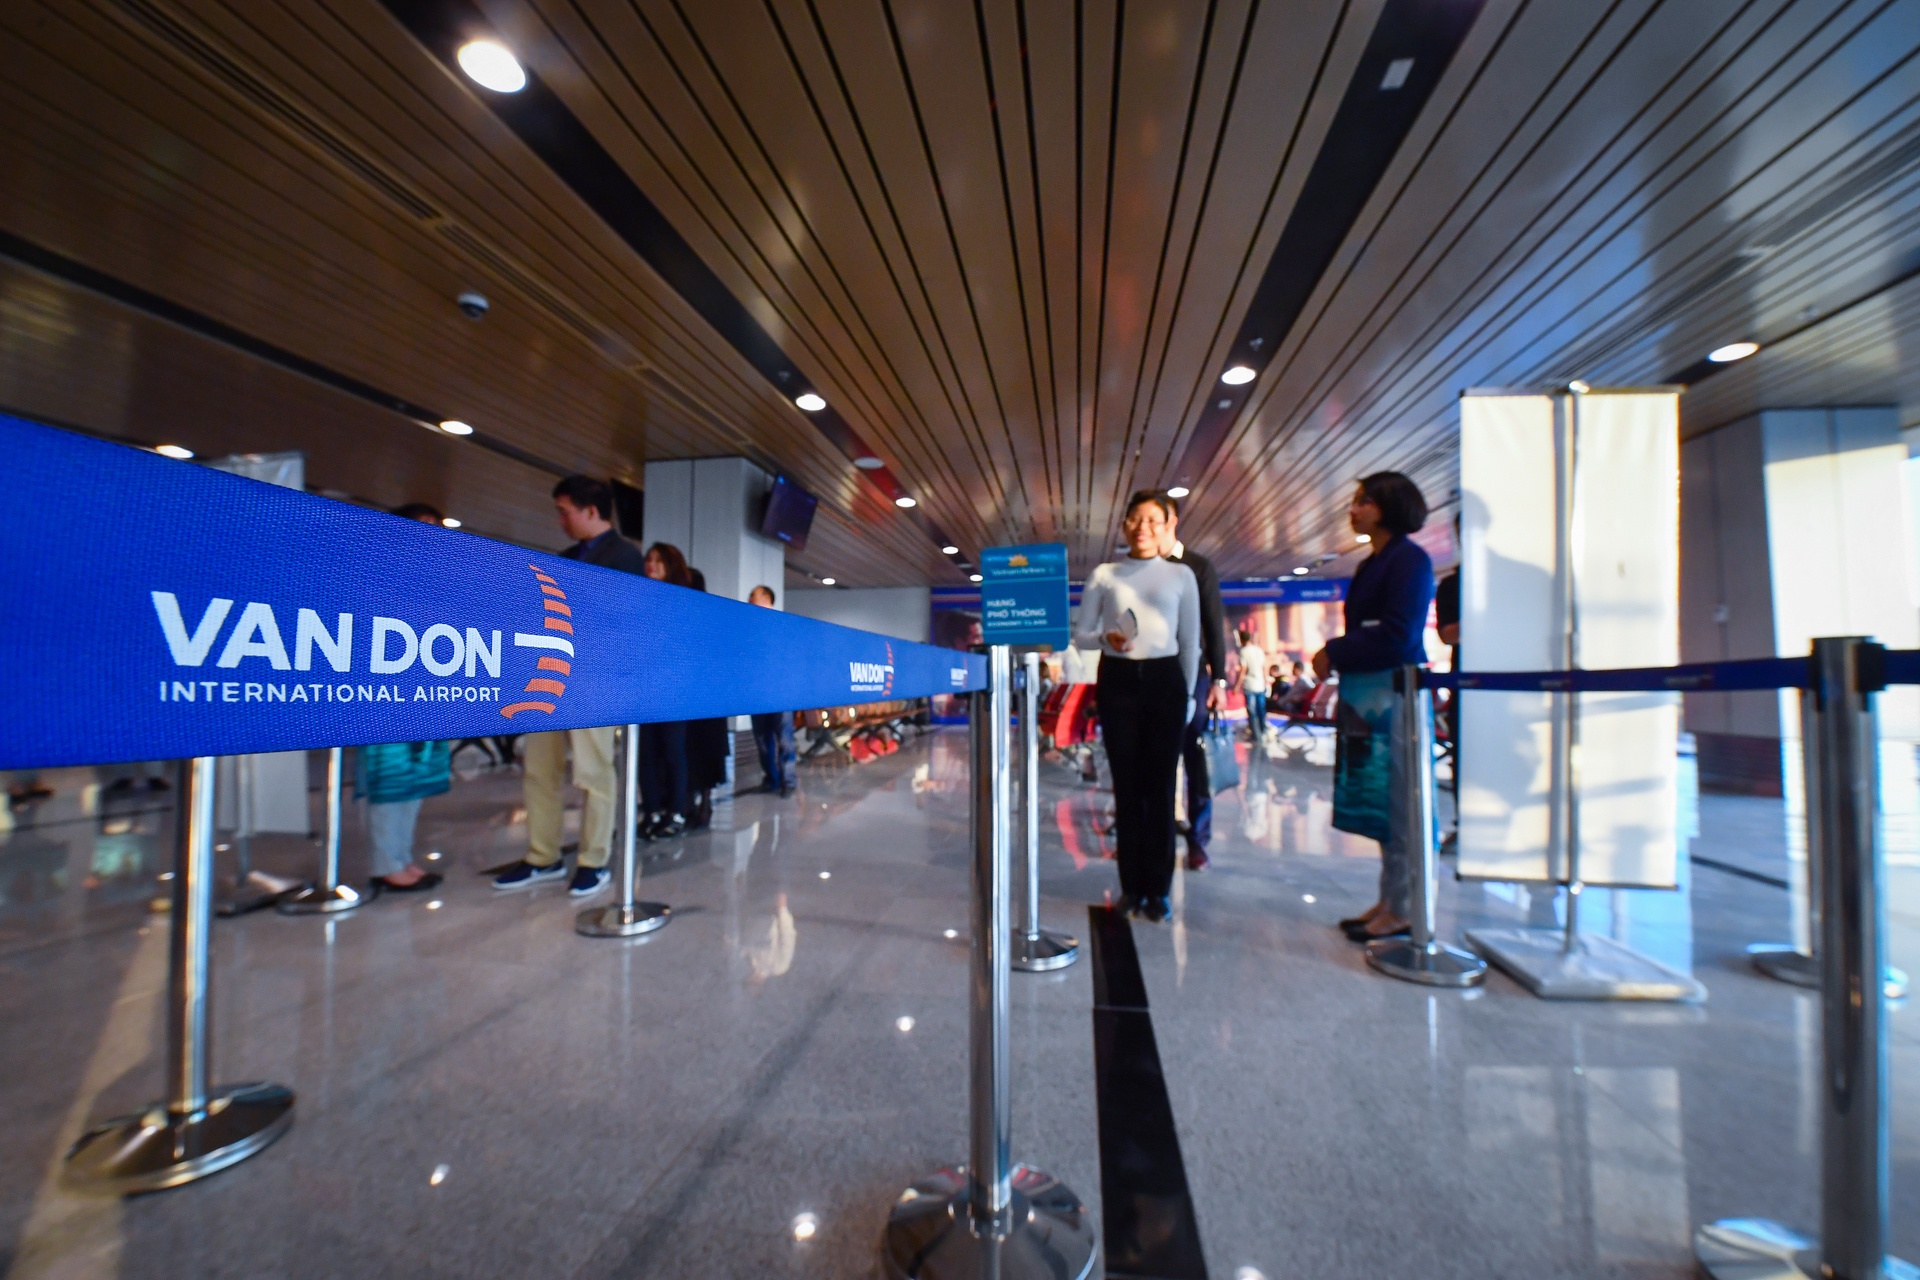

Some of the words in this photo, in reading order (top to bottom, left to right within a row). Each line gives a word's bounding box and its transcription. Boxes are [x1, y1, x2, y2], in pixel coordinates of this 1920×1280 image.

[151, 590, 353, 673] VAN
[369, 616, 502, 678] DON
[850, 662, 868, 683] VAN
[868, 663, 885, 683] DON
[160, 681, 405, 702] INTERNATIONAL
[413, 686, 501, 702] AIRPORT
